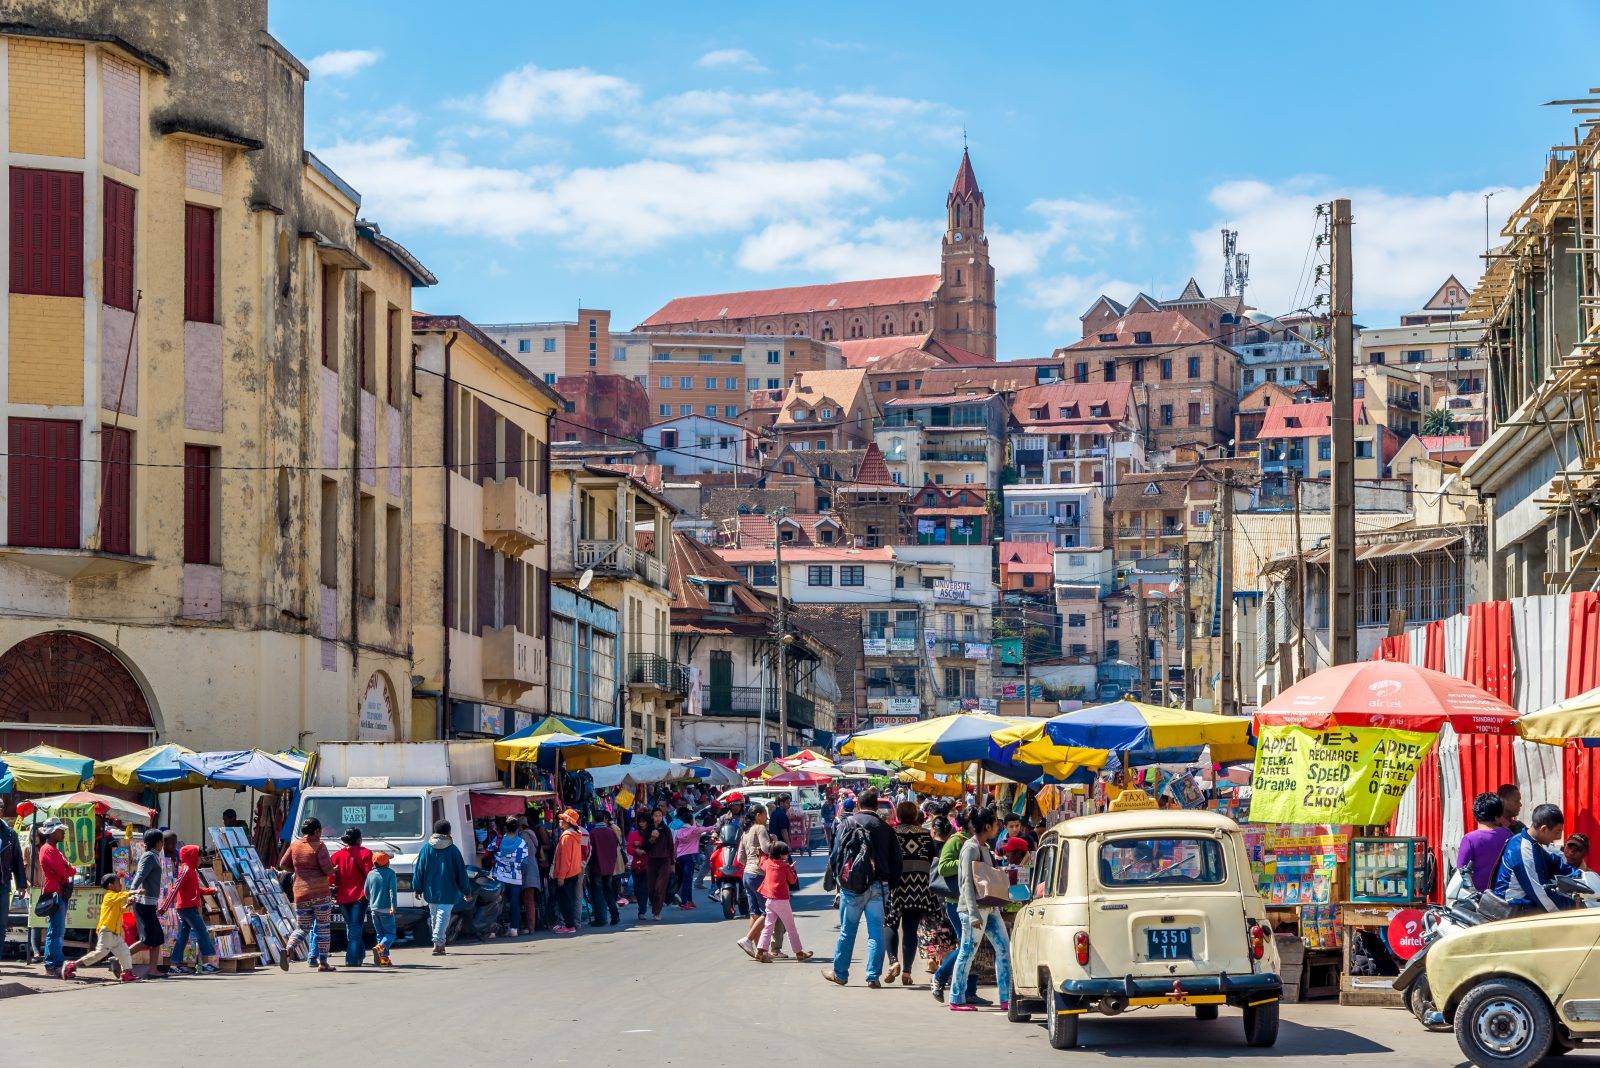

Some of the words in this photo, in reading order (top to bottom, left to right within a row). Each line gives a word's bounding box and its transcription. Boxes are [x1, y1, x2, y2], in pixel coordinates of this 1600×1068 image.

[1261, 736, 1297, 753] APPEL
[1374, 739, 1421, 759] APPEL
[1261, 756, 1293, 765] TELMA
[1374, 759, 1414, 772] TELMA
[1258, 765, 1290, 775] AIRTEL
[1255, 776, 1296, 791] Orange
[1122, 793, 1146, 802] TAXI
[1152, 930, 1187, 944] 4350
[1400, 937, 1422, 946] airtel
[1161, 945, 1177, 958] TV
